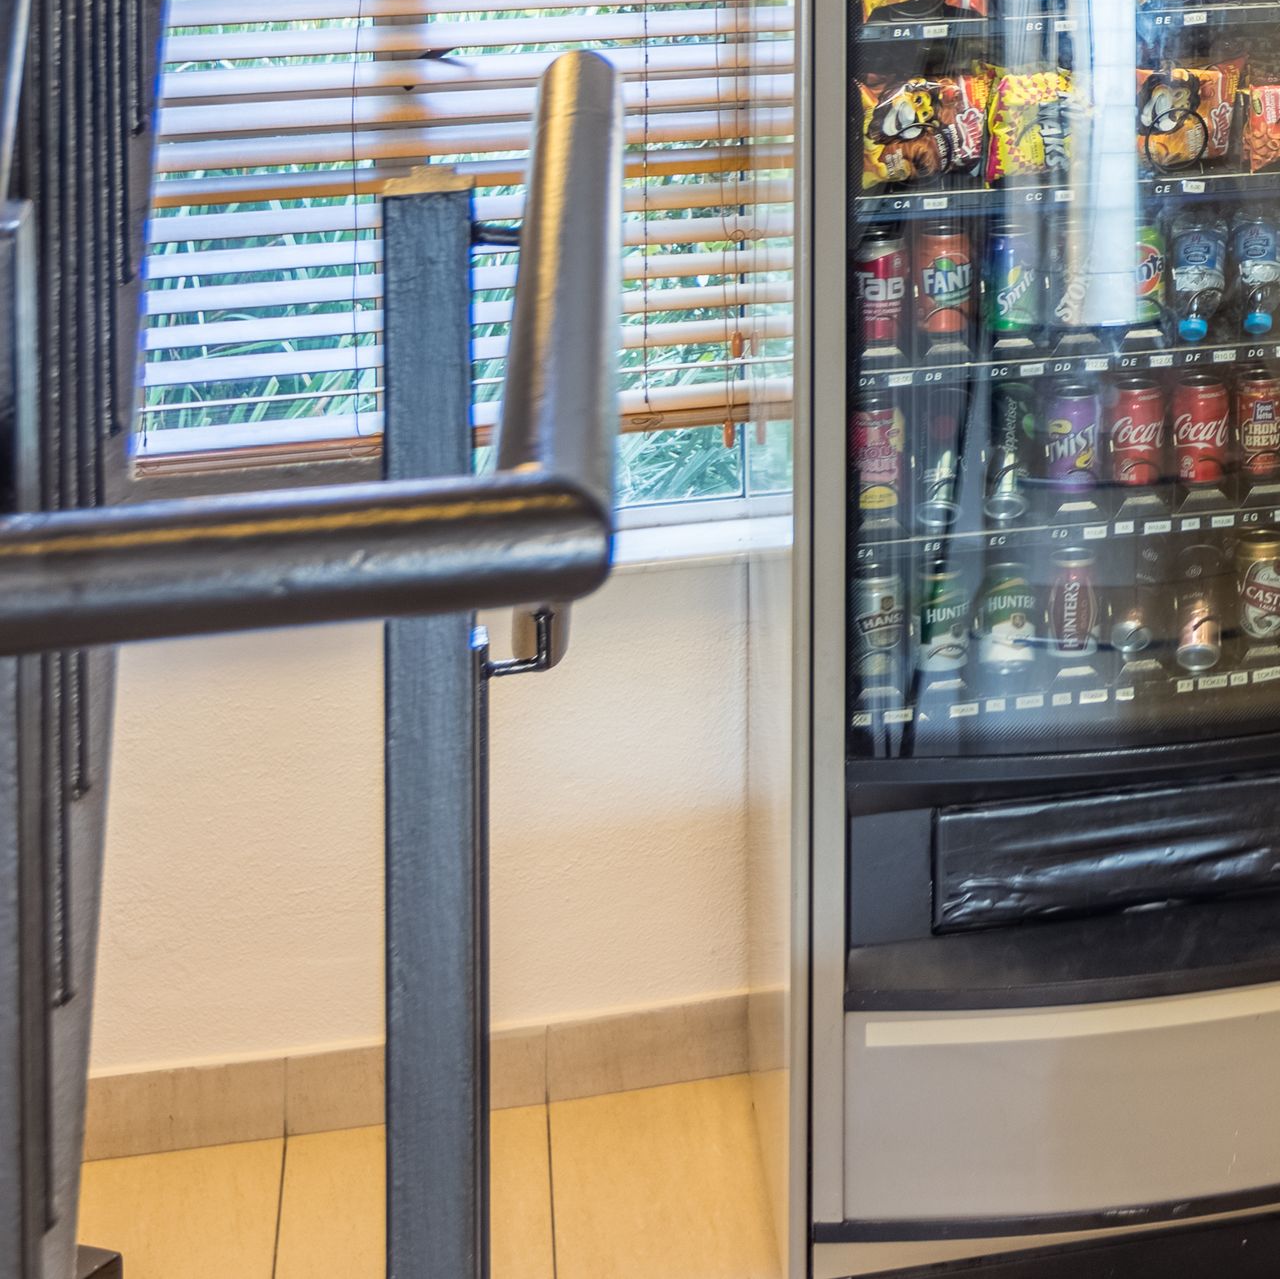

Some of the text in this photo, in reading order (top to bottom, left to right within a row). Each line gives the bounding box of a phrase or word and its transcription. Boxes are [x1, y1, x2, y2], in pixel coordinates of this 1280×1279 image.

[1025, 22, 1044, 32] BC
[893, 28, 911, 38] BA
[1154, 184, 1171, 194] CE
[1025, 192, 1043, 202] CC
[893, 200, 911, 210] CA
[1185, 352, 1201, 362] DF
[1248, 348, 1265, 358] DG
[1054, 362, 1072, 372] DD
[1121, 358, 1138, 367] DE
[925, 372, 943, 382] DB
[991, 367, 1009, 377] DC
[858, 377, 876, 387] DA
[1247, 422, 1279, 435] IRON
[1245, 433, 1280, 446] BREW
[1243, 512, 1259, 522] EG
[1051, 529, 1068, 539] ED
[989, 536, 1007, 546] EC
[923, 542, 941, 552] EB
[857, 549, 874, 559] EA
